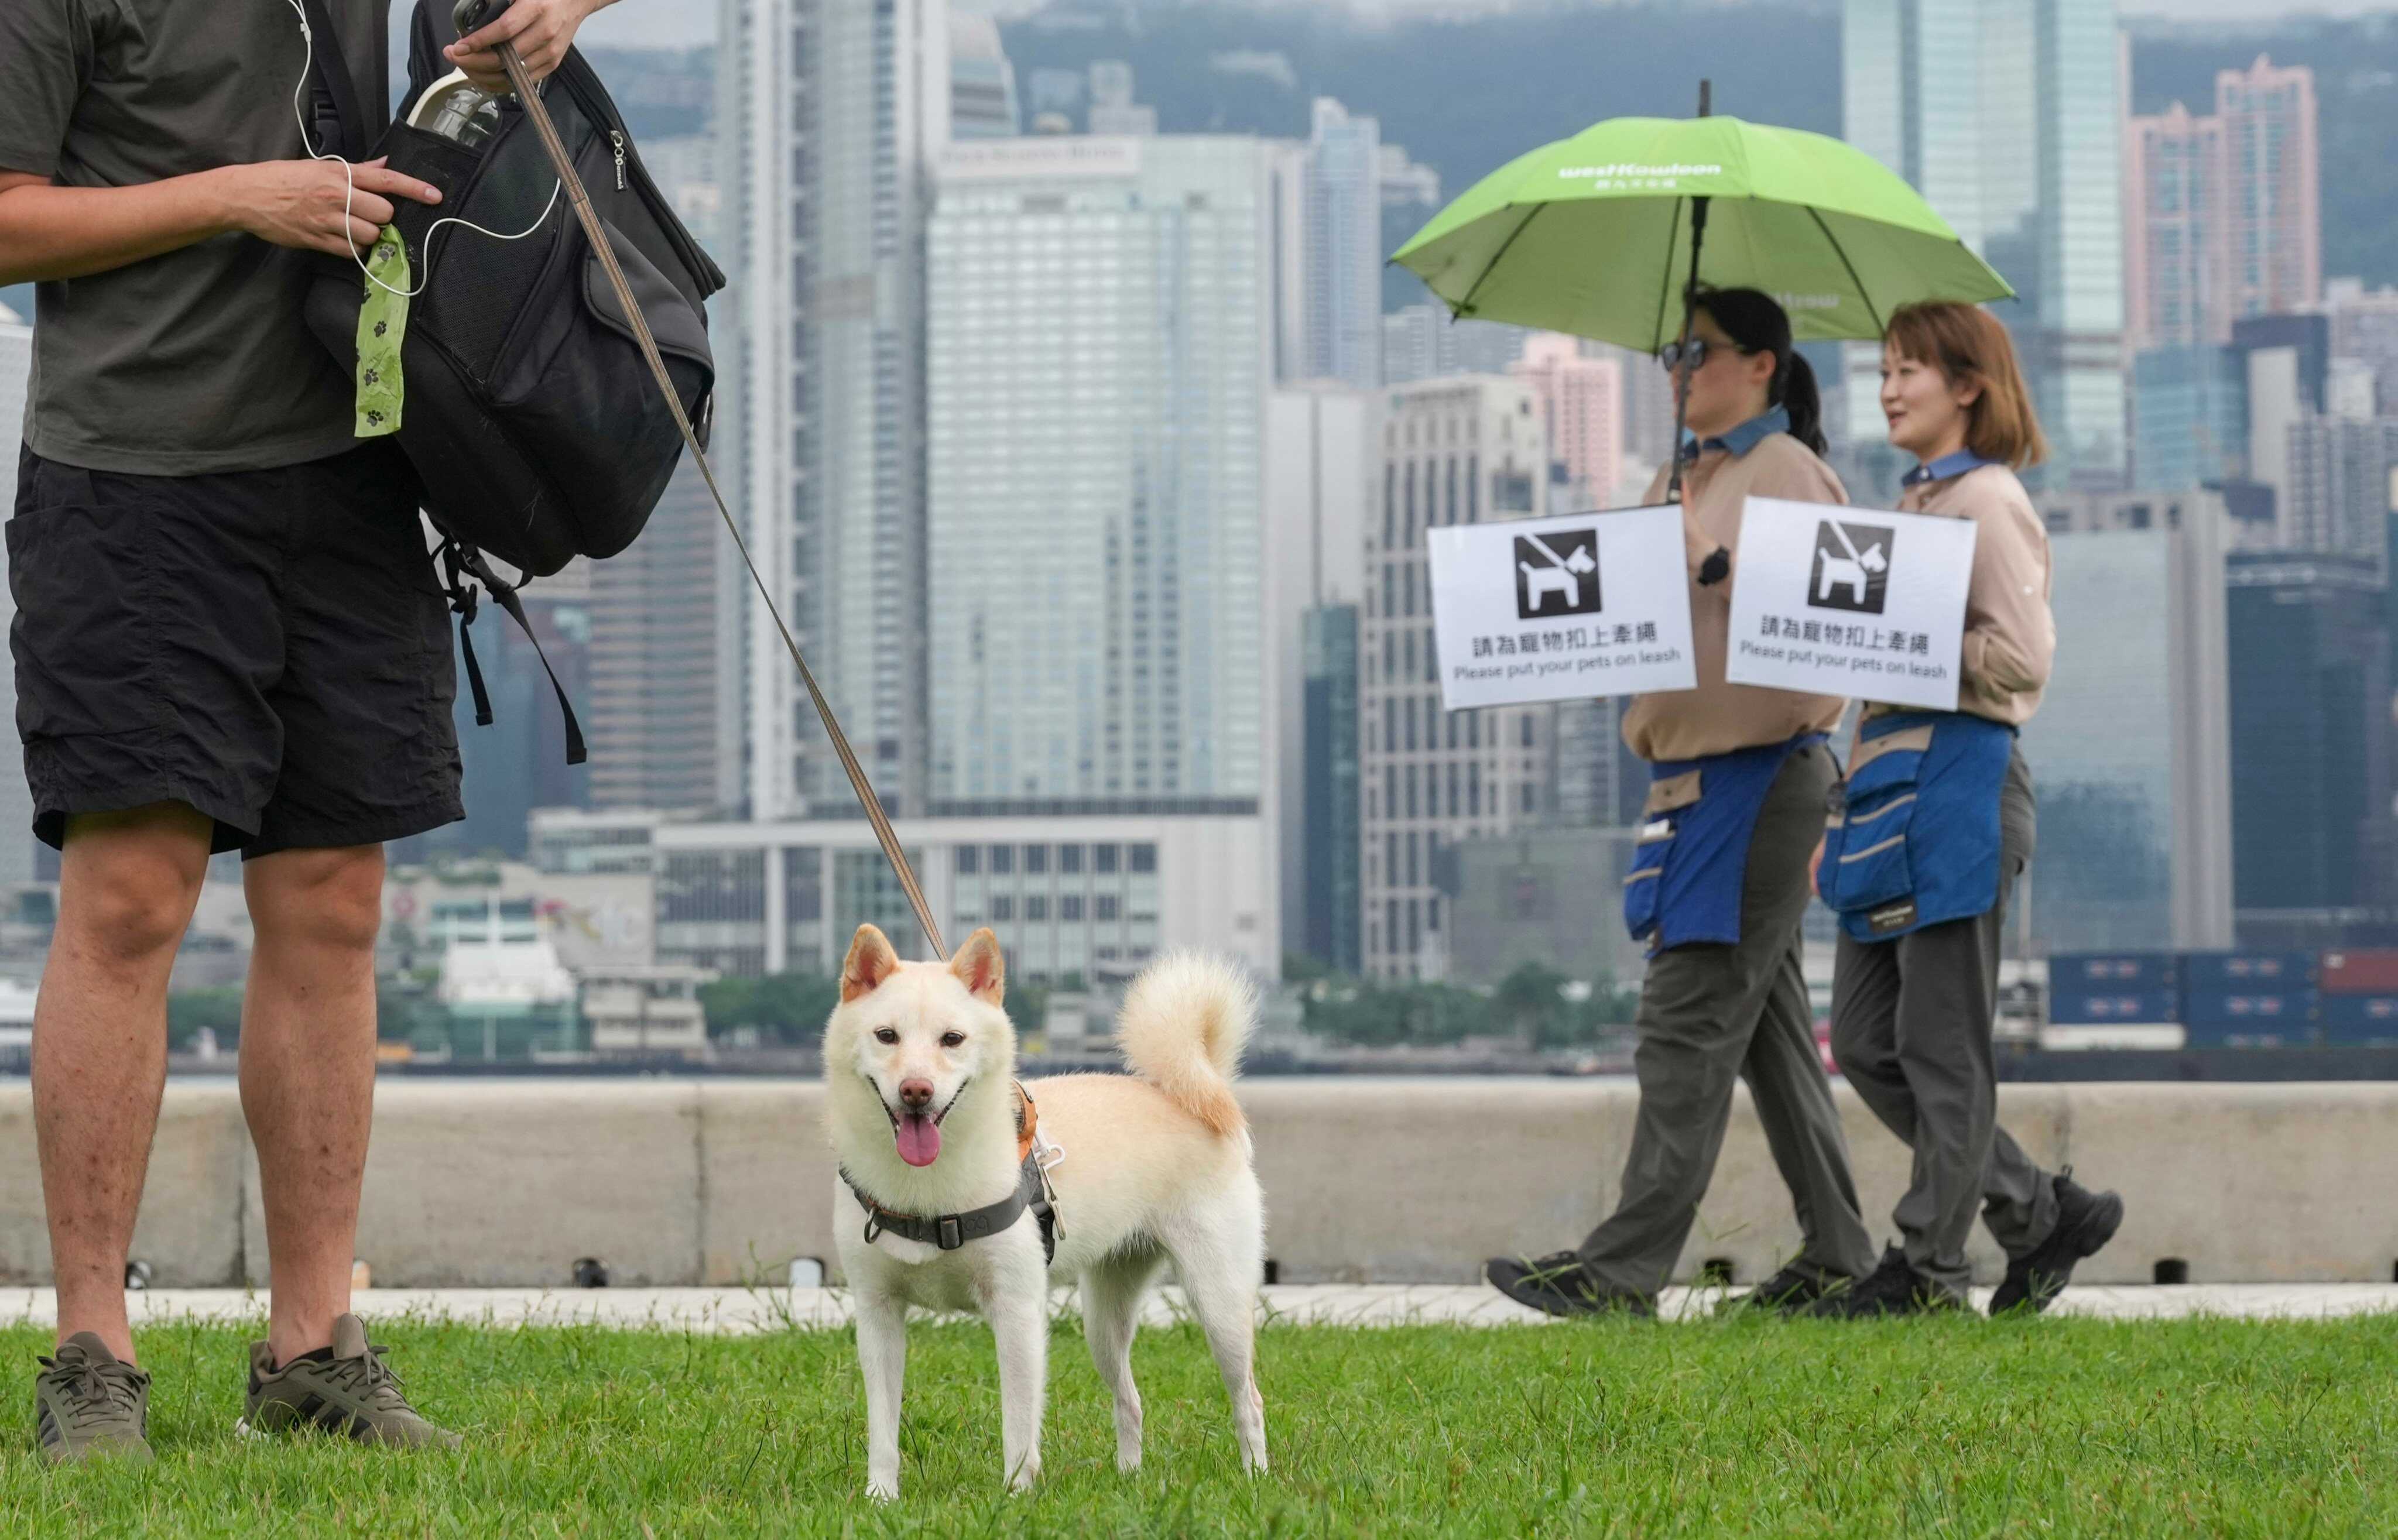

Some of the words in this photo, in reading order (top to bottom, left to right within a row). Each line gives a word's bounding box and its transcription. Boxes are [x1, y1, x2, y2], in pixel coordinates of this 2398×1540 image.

[1472, 621, 1657, 658] 請為寵物扣上牽繩
[1760, 615, 1930, 656] 請為寵物扣上牽繩
[1454, 665, 1503, 680] Please
[1507, 662, 1533, 679] put
[1537, 660, 1573, 678] your
[1577, 656, 1611, 673] pets
[1614, 654, 1636, 667] on
[1639, 647, 1681, 664] leash
[1740, 639, 1784, 659] Please
[1787, 649, 1812, 664] put
[1815, 653, 1847, 668] your
[1851, 657, 1883, 671] pets
[1886, 661, 1906, 674] on
[1909, 661, 1947, 679] leash
